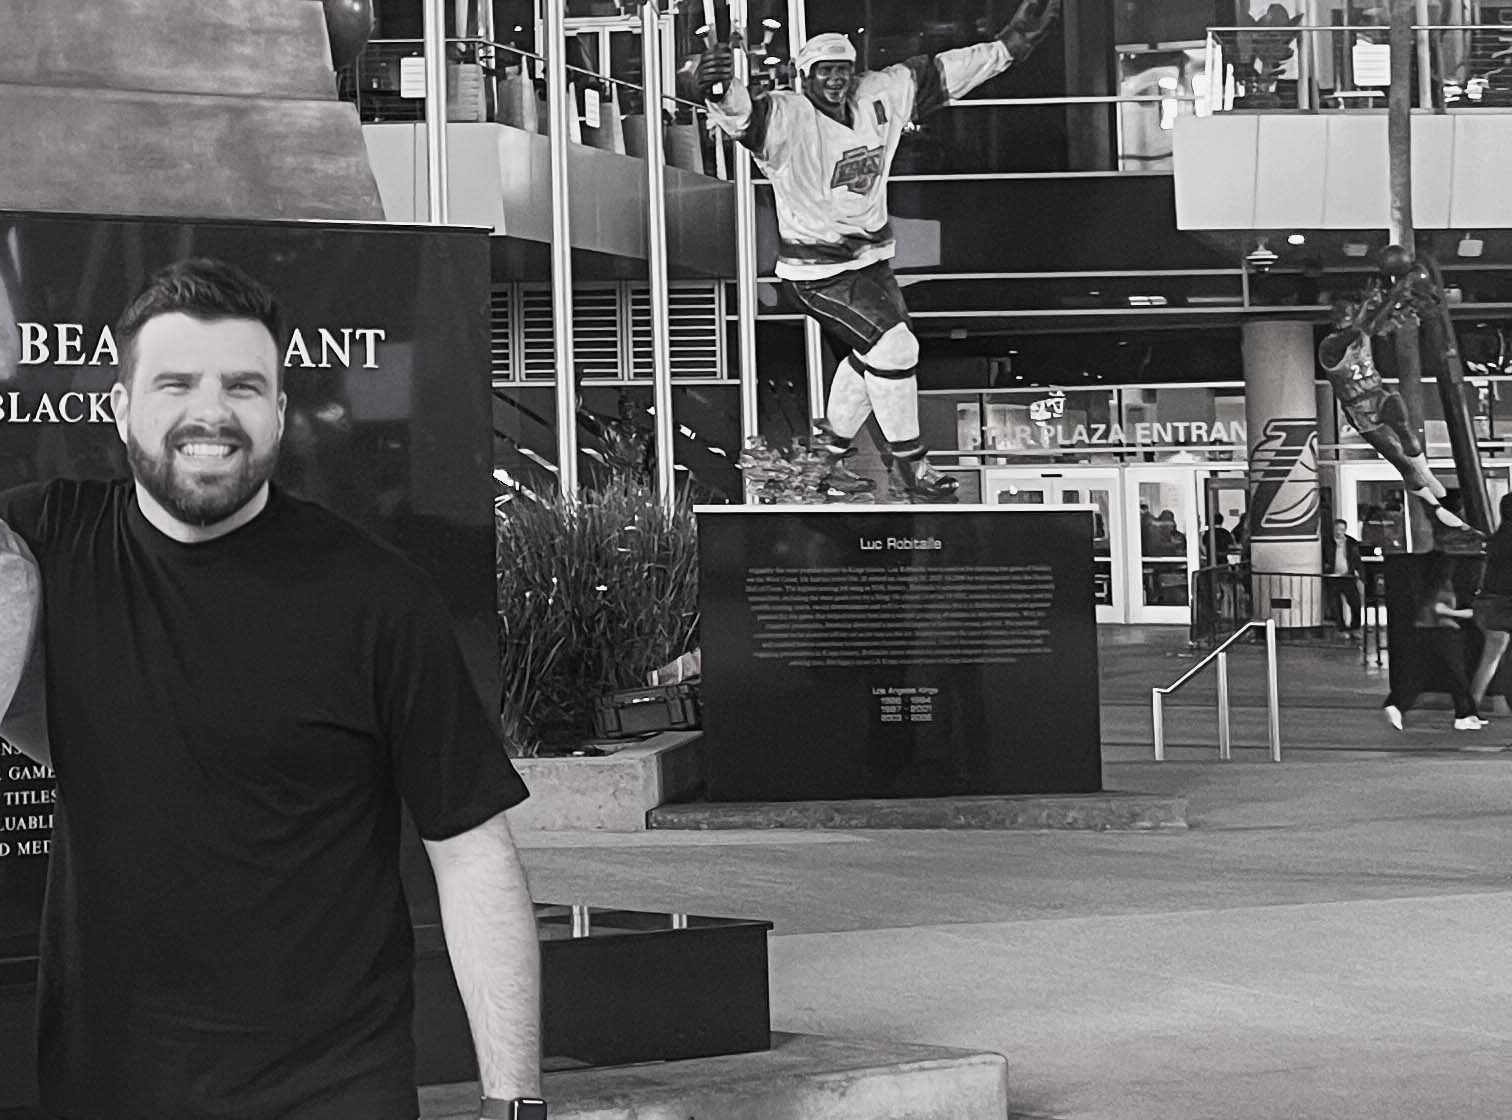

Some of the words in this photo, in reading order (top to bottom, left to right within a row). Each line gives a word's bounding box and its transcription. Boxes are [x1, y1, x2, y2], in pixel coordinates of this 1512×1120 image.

[17, 323, 119, 366] BEA
[284, 328, 386, 369] ANT
[1040, 424, 1126, 447] PLAZA
[1135, 420, 1247, 443] ENTRAN
[859, 537, 883, 550] Luc
[8, 765, 56, 781] GAME
